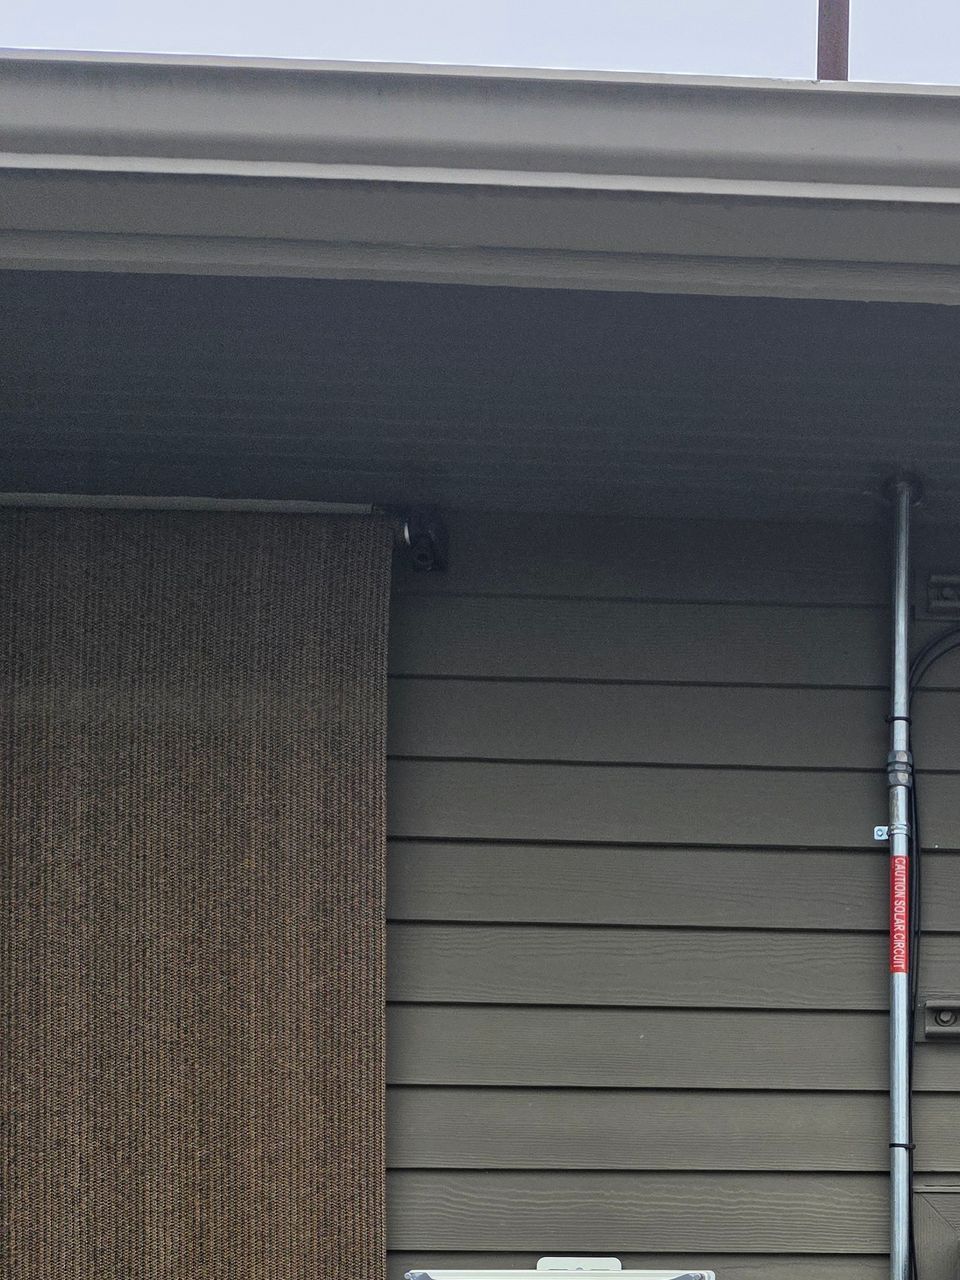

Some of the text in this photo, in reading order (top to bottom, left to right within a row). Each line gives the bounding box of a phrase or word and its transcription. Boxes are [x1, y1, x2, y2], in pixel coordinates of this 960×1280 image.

[893, 858, 906, 970] CAUTION SOLAR CIRCUIT
